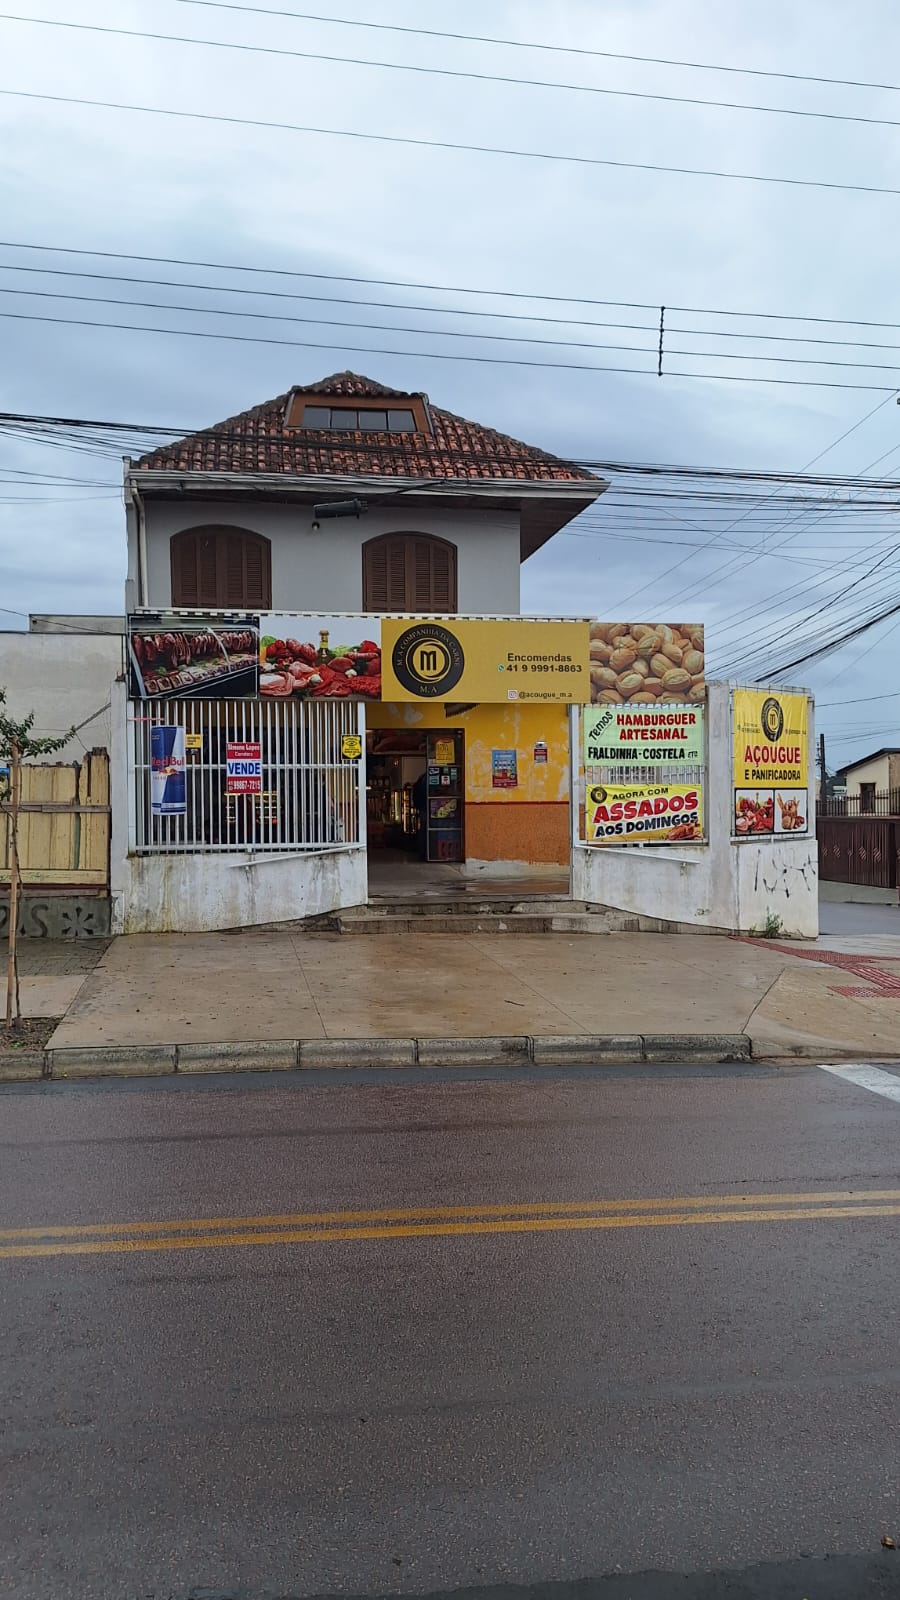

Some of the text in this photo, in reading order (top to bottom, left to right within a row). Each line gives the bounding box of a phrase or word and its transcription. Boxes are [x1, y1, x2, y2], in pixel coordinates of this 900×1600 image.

[507, 652, 572, 662] Encomendas
[506, 664, 582, 672] 41 9 9991-8863
[616, 713, 696, 726] HAMBURGUER
[619, 727, 688, 741] ARTESANAL
[744, 745, 801, 767] AÇOUGUE
[228, 762, 261, 775] VENDE
[744, 769, 801, 781] E PANIFICADORA
[612, 787, 669, 800] AGORA COM
[593, 791, 699, 824] ASSADOS
[595, 811, 698, 838] AOS DOMINGOS
